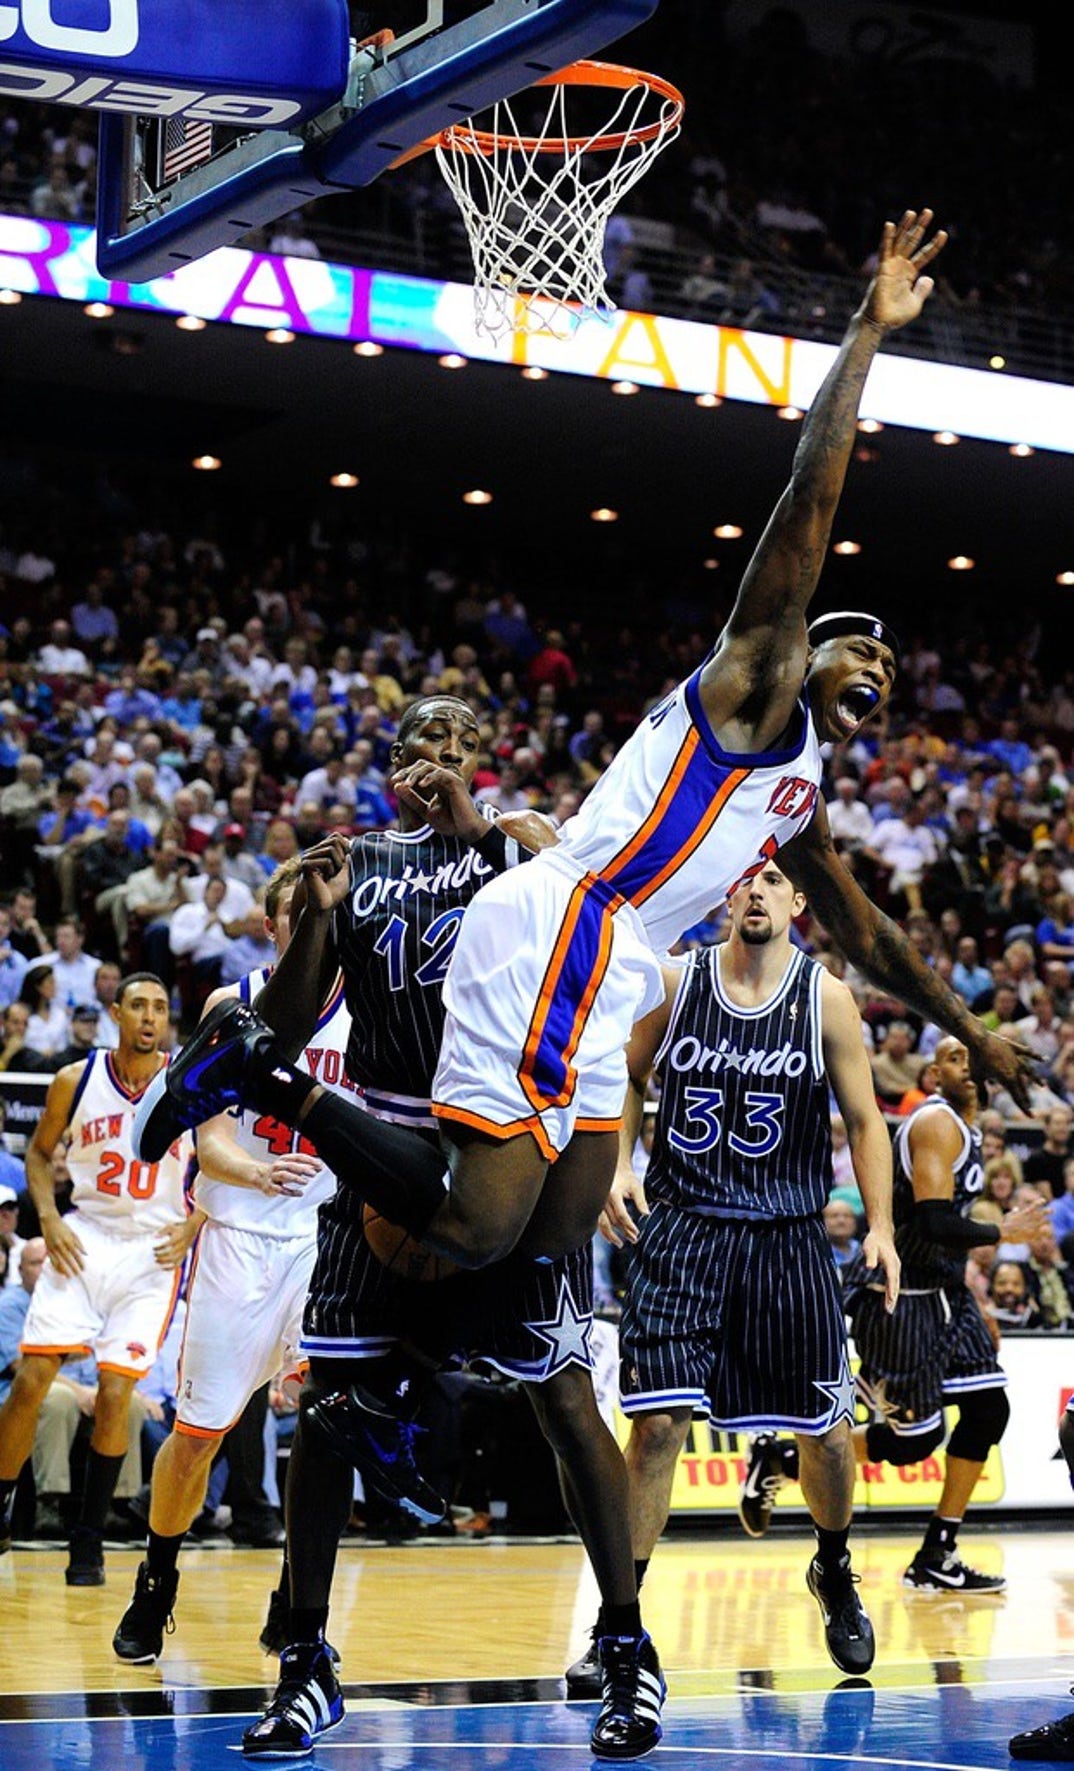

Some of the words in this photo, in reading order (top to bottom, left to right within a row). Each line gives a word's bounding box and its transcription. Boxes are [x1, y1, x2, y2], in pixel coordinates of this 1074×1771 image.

[512, 291, 794, 408] FAN
[373, 906, 468, 992] 12
[305, 1047, 366, 1098] YO
[81, 1112, 124, 1149] NEW
[667, 1086, 785, 1158] 33
[96, 1150, 160, 1200] 20
